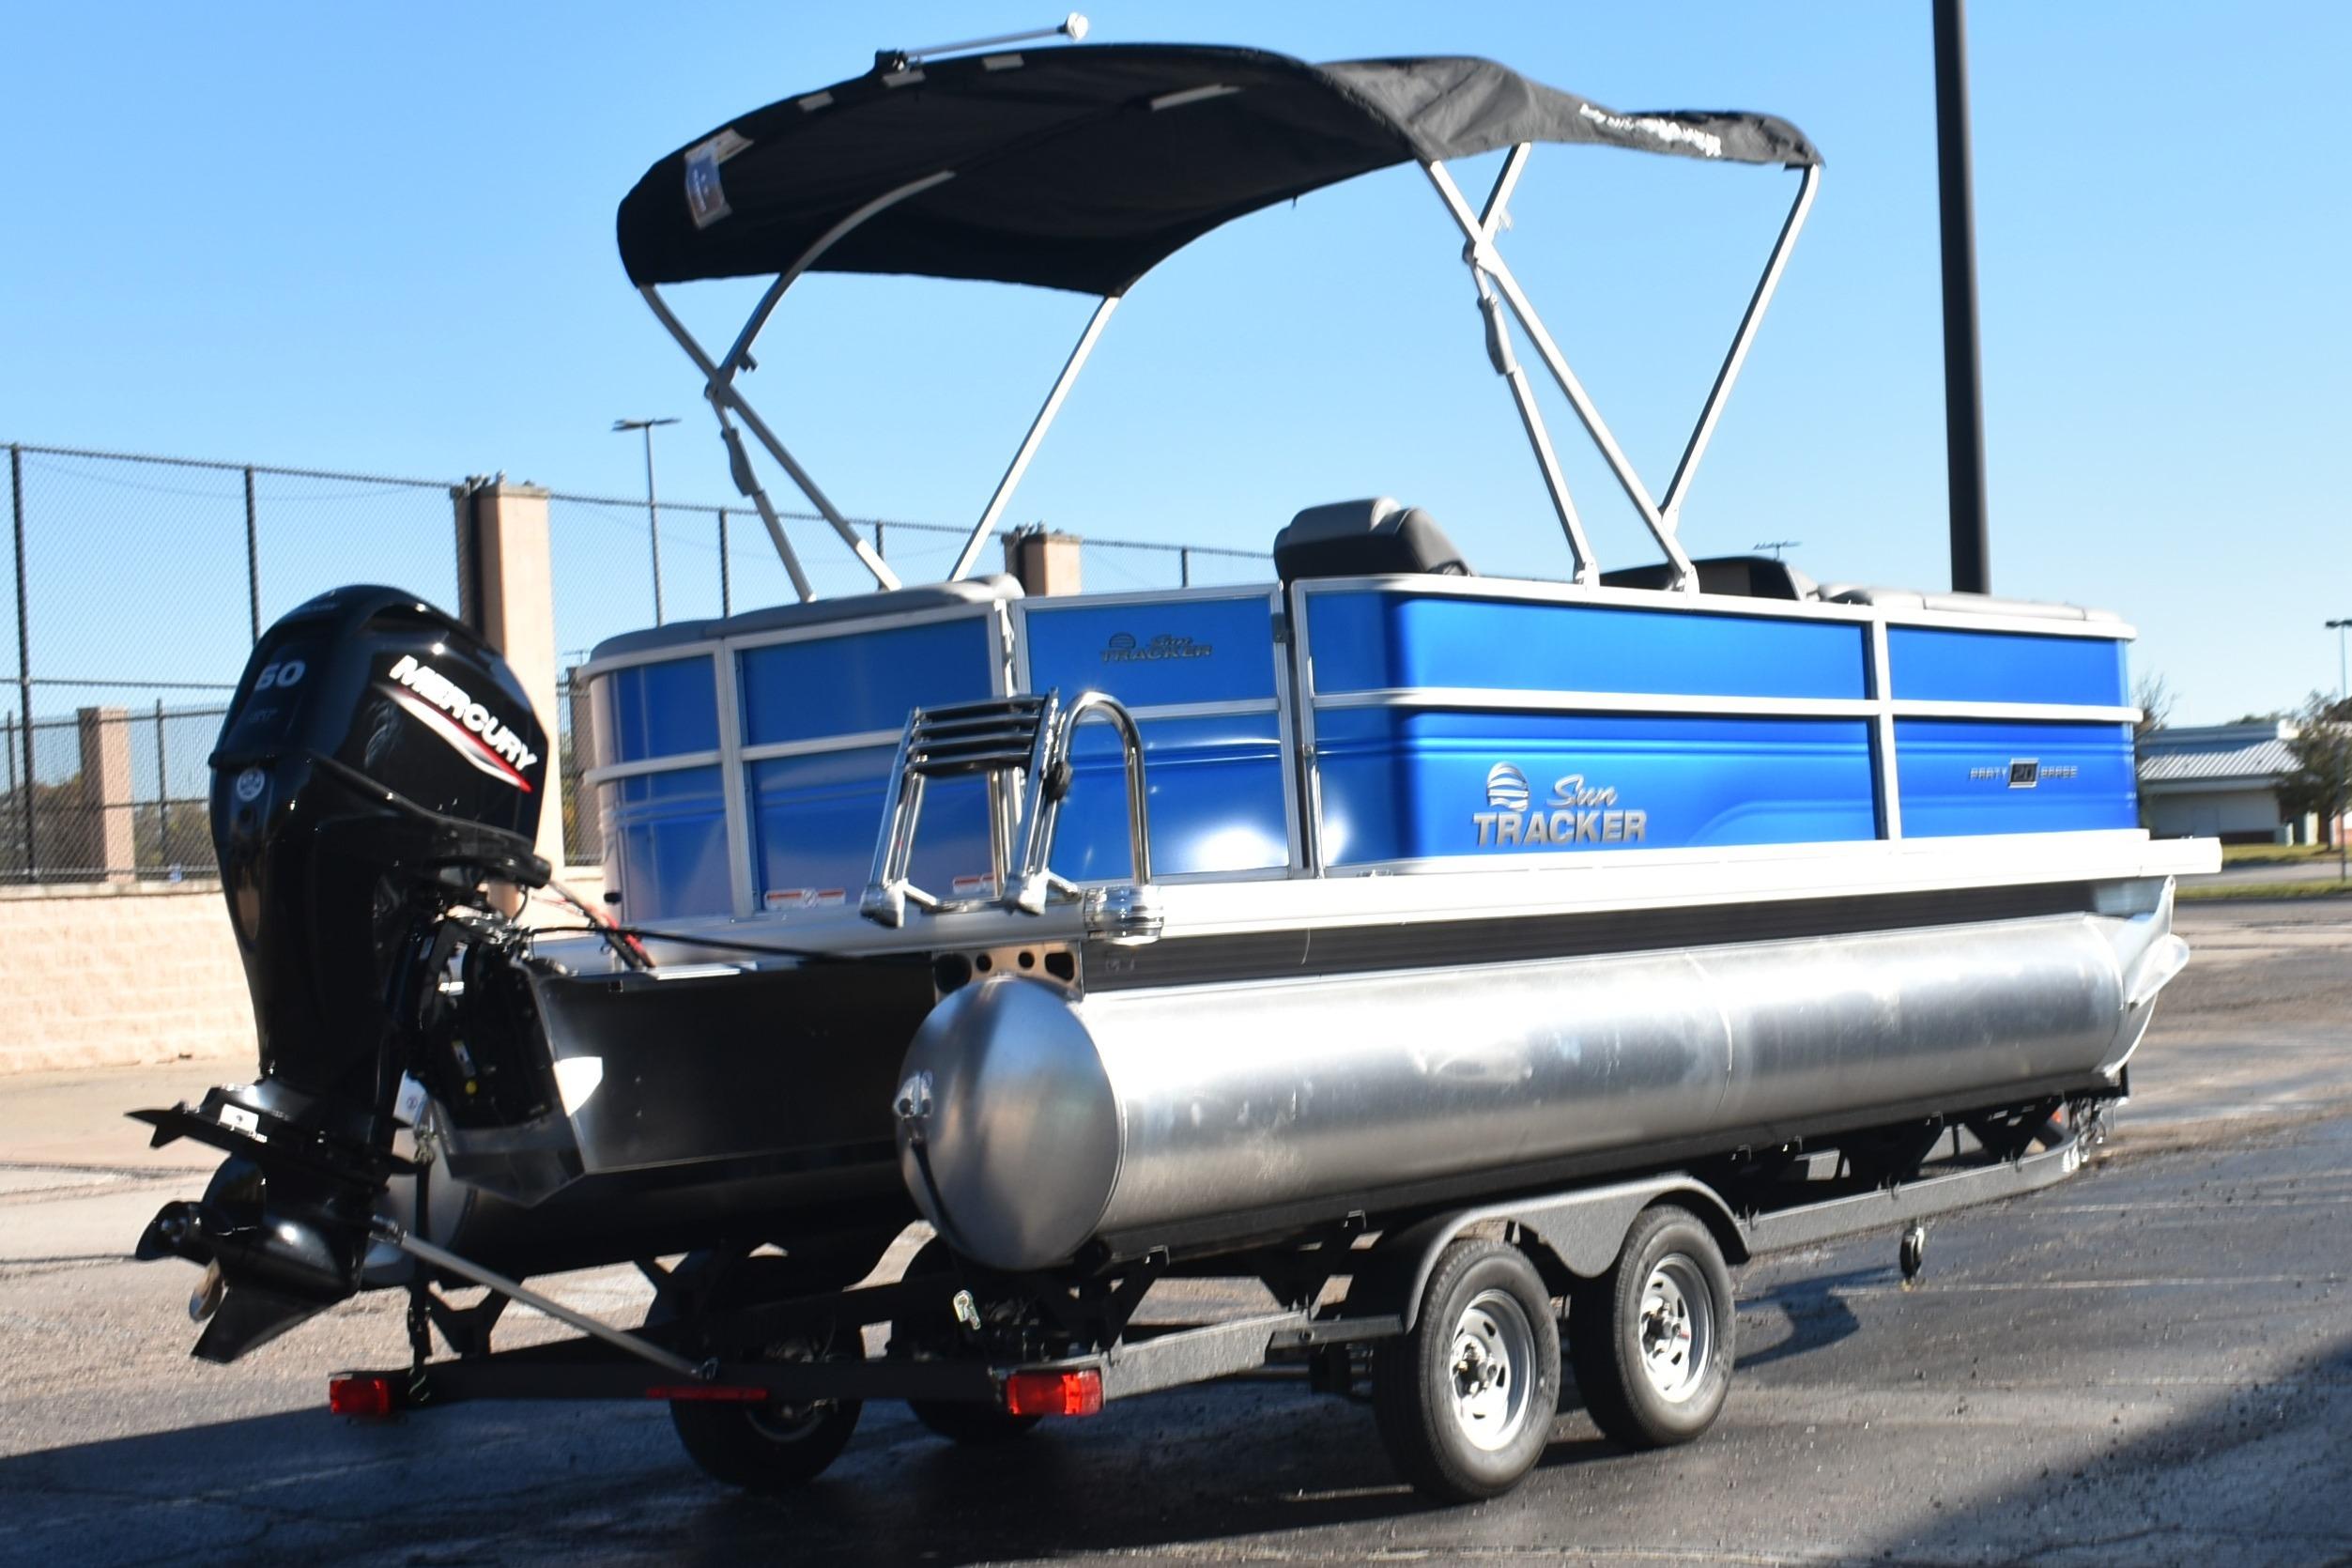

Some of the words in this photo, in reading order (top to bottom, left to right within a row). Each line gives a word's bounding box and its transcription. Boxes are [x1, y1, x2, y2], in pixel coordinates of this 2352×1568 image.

[1101, 644, 1212, 662] TRACKER
[389, 655, 537, 771] MERCURY
[1546, 774, 1618, 808] Sun
[1471, 809, 1648, 847] TRACKER
